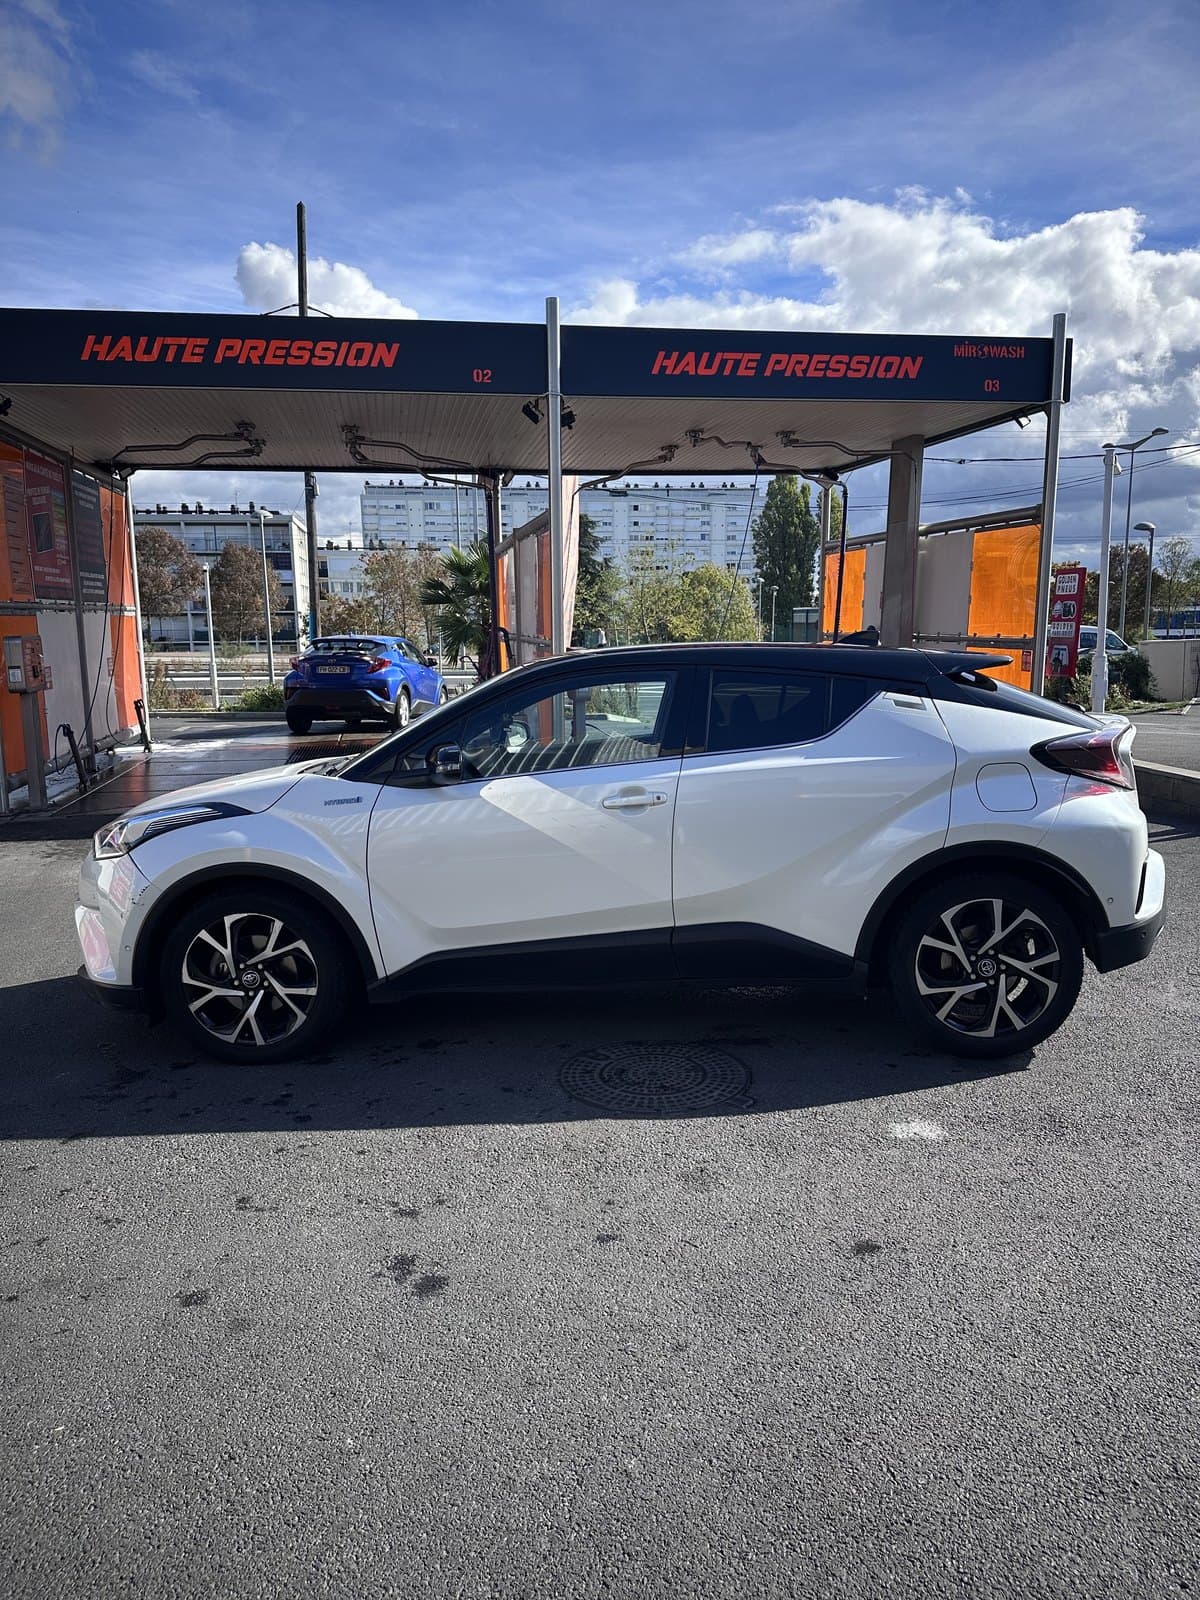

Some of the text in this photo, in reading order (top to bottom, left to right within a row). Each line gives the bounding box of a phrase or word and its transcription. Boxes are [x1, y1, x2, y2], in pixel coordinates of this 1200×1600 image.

[80, 335, 400, 368] HAUTE PRESSION
[651, 351, 923, 379] HAUTE PRESSION
[472, 369, 492, 383] 02
[984, 379, 1001, 392] 03
[1058, 575, 1077, 585] GOLDEN
[1056, 584, 1076, 593] PNEUS
[1052, 622, 1073, 631] GOLDEN
